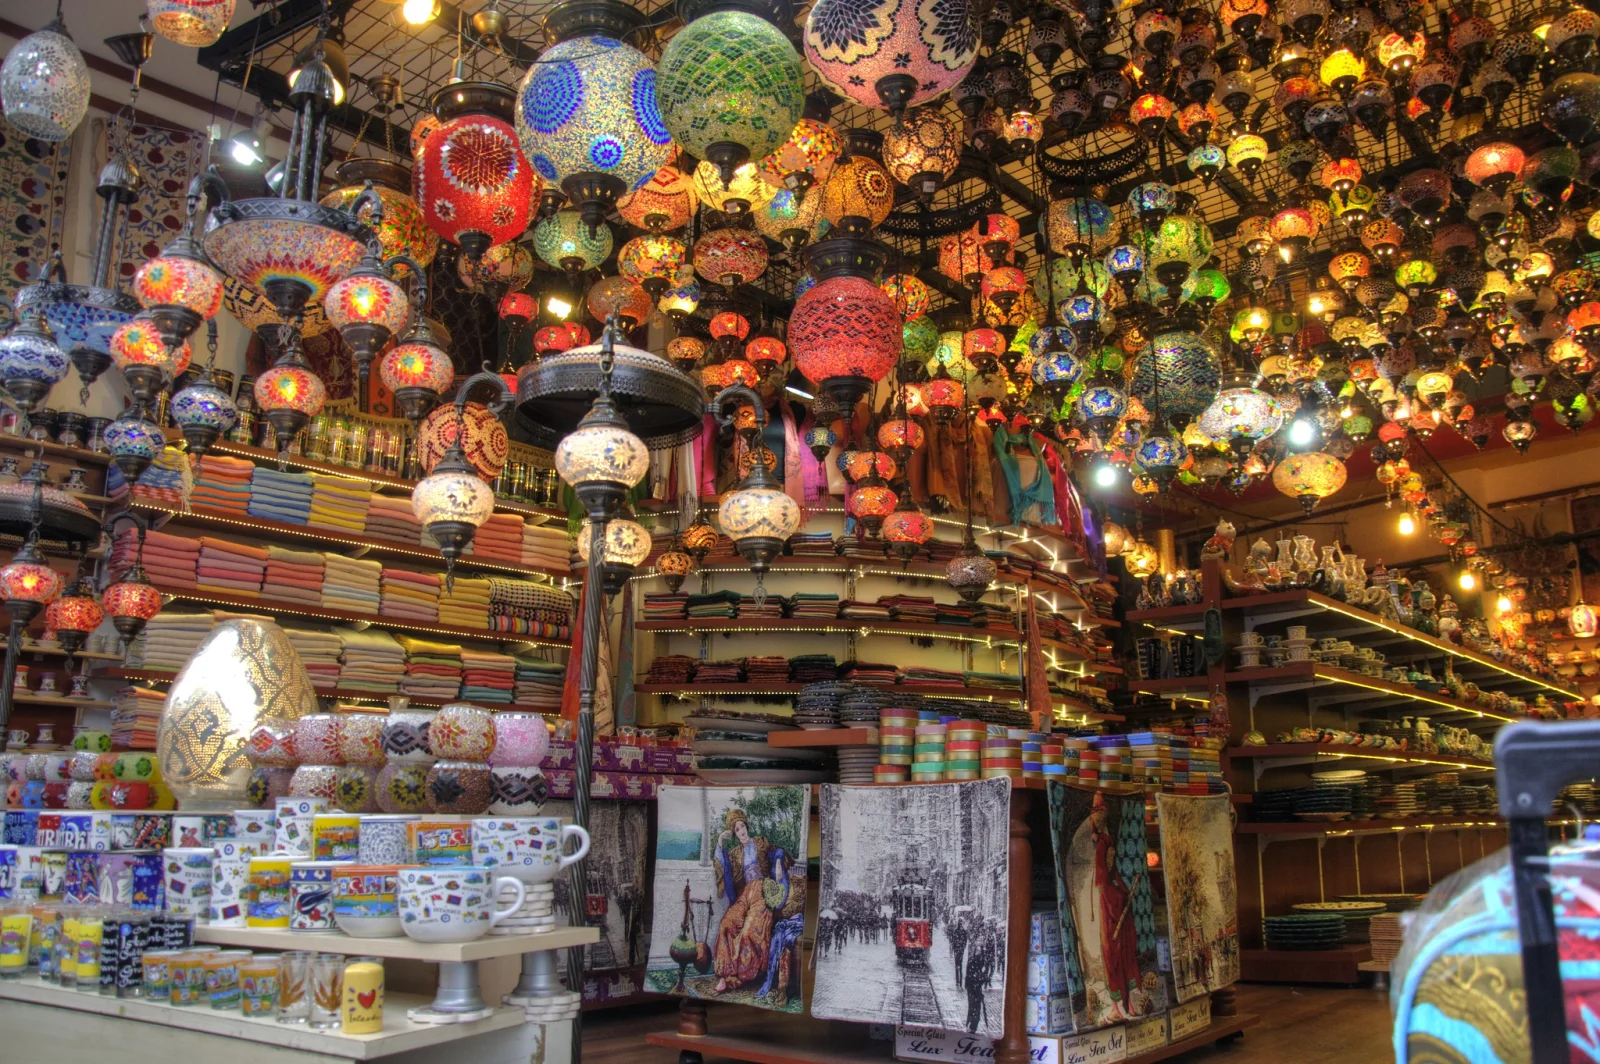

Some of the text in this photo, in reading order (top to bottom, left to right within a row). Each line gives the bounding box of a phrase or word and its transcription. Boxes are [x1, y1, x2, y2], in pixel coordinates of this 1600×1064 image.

[897, 1027, 946, 1040] Special Glass
[907, 1040, 943, 1055] Lux
[1067, 1032, 1123, 1064] Lux Tea Set
